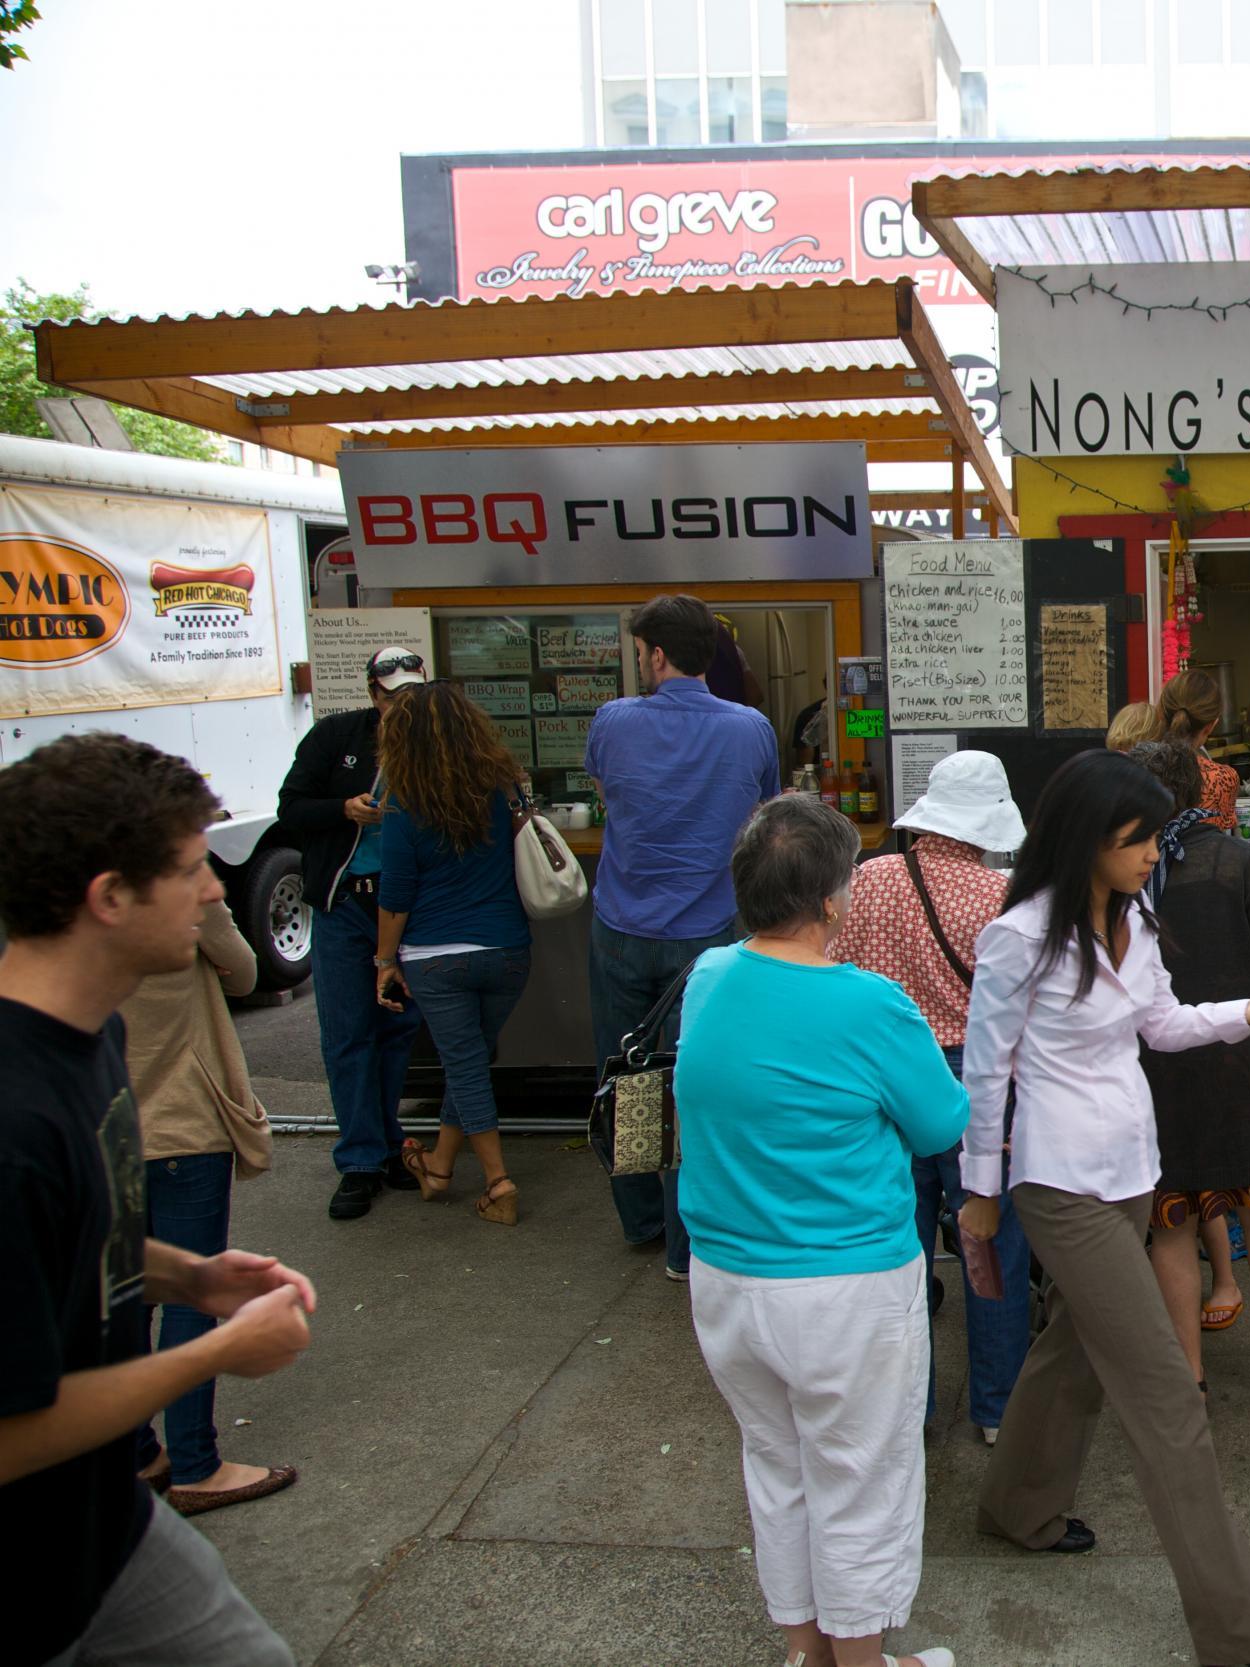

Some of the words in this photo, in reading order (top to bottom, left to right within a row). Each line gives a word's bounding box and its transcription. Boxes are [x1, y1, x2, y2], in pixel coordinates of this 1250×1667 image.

[537, 187, 623, 238] carl
[629, 189, 777, 253] greve
[476, 247, 593, 296] Jewelry
[624, 251, 730, 288] Timepiece
[735, 236, 845, 277] Collections
[356, 492, 548, 556] BBQ
[564, 494, 858, 542] FUSION
[911, 552, 949, 573] Food
[954, 551, 992, 573] Menu
[0, 571, 114, 607] YMPIC
[164, 588, 184, 605] RED
[186, 586, 205, 601] HOT
[205, 585, 246, 605] CHICAGO
[889, 582, 939, 598] Chicken
[944, 580, 967, 597] and
[968, 582, 992, 597] rice
[1052, 609, 1092, 620] Drinks
[39, 616, 89, 638] Dogs
[313, 617, 343, 628] About
[889, 616, 919, 628] Extra
[924, 618, 959, 628] sauce
[1001, 617, 1022, 628] 1.00
[164, 632, 185, 641] PURE
[187, 632, 207, 640] BEEF
[211, 630, 250, 639] PRODUCTS
[540, 629, 569, 647] Beef
[890, 630, 919, 643] Extra
[921, 630, 963, 643] chicken
[1000, 632, 1025, 643] 2.00
[314, 639, 338, 647] Hickory
[891, 643, 912, 655] Add
[914, 643, 957, 654] chicken
[962, 644, 985, 654] liver
[1001, 646, 1023, 656] 1.00
[150, 652, 158, 663] A
[158, 650, 186, 664] Family
[187, 649, 225, 661] Tradition
[225, 648, 243, 659] Since
[244, 647, 263, 658] 1893
[341, 652, 356, 660] Early
[890, 658, 920, 669] Extra
[924, 659, 949, 668] rice
[999, 661, 1023, 669] 2.00
[995, 674, 1026, 686] 10.00
[468, 684, 495, 697] BBQ
[497, 684, 526, 698] Wrap
[559, 687, 615, 703] Chicken
[898, 697, 937, 707] THANK
[942, 696, 964, 706] YOU
[969, 694, 992, 705] FOR
[999, 692, 1023, 703] YOUR
[501, 702, 526, 711] $5.00
[498, 725, 529, 738] Pork
[538, 720, 568, 733] Pork
